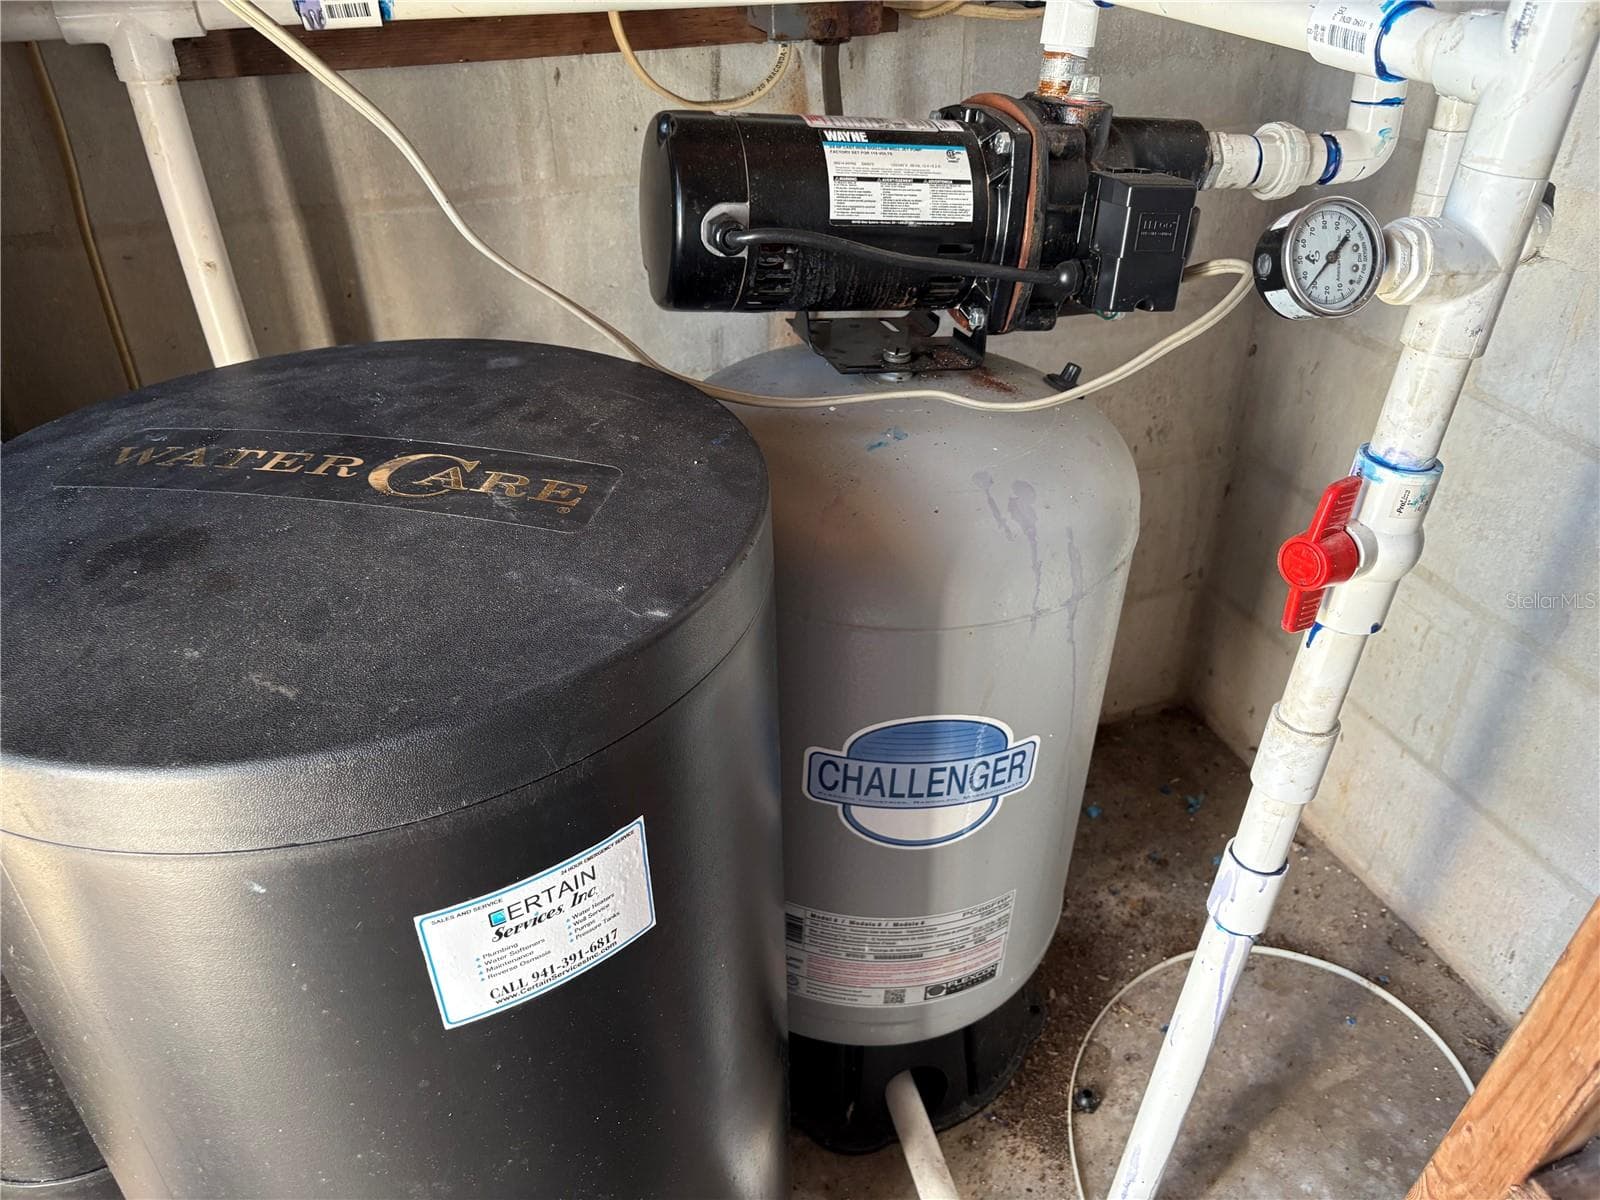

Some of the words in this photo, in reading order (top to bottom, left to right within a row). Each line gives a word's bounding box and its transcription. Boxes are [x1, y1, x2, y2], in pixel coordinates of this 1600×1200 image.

[823, 130, 869, 143] WAYNE
[1309, 226, 1316, 237] 70
[1322, 220, 1328, 230] 80
[1334, 221, 1340, 231] 90
[1301, 238, 1307, 248] 60
[1302, 271, 1308, 281] 40
[1324, 285, 1330, 296] 20
[1337, 282, 1343, 291] 10
[817, 749, 1027, 799] CHALLENGER
[431, 913, 455, 926] SALES
[456, 909, 472, 920] AND
[473, 898, 503, 912] SERVICE
[571, 907, 591, 921] Water
[572, 916, 587, 927] Well
[588, 903, 610, 918] Service
[574, 919, 596, 934] Pumps
[575, 923, 602, 940] Pressure
[603, 911, 621, 924] Tanks
[482, 943, 519, 960] Plumbing
[484, 954, 507, 966] Water
[509, 938, 545, 957] Softeners
[486, 950, 534, 973] Maintenance
[487, 965, 518, 980] Reverse
[519, 950, 552, 967] Osmosis
[489, 978, 529, 1000] CALL
[531, 927, 619, 982] 941-391-6817
[495, 940, 619, 1005] www.CertainServicesInc.com
